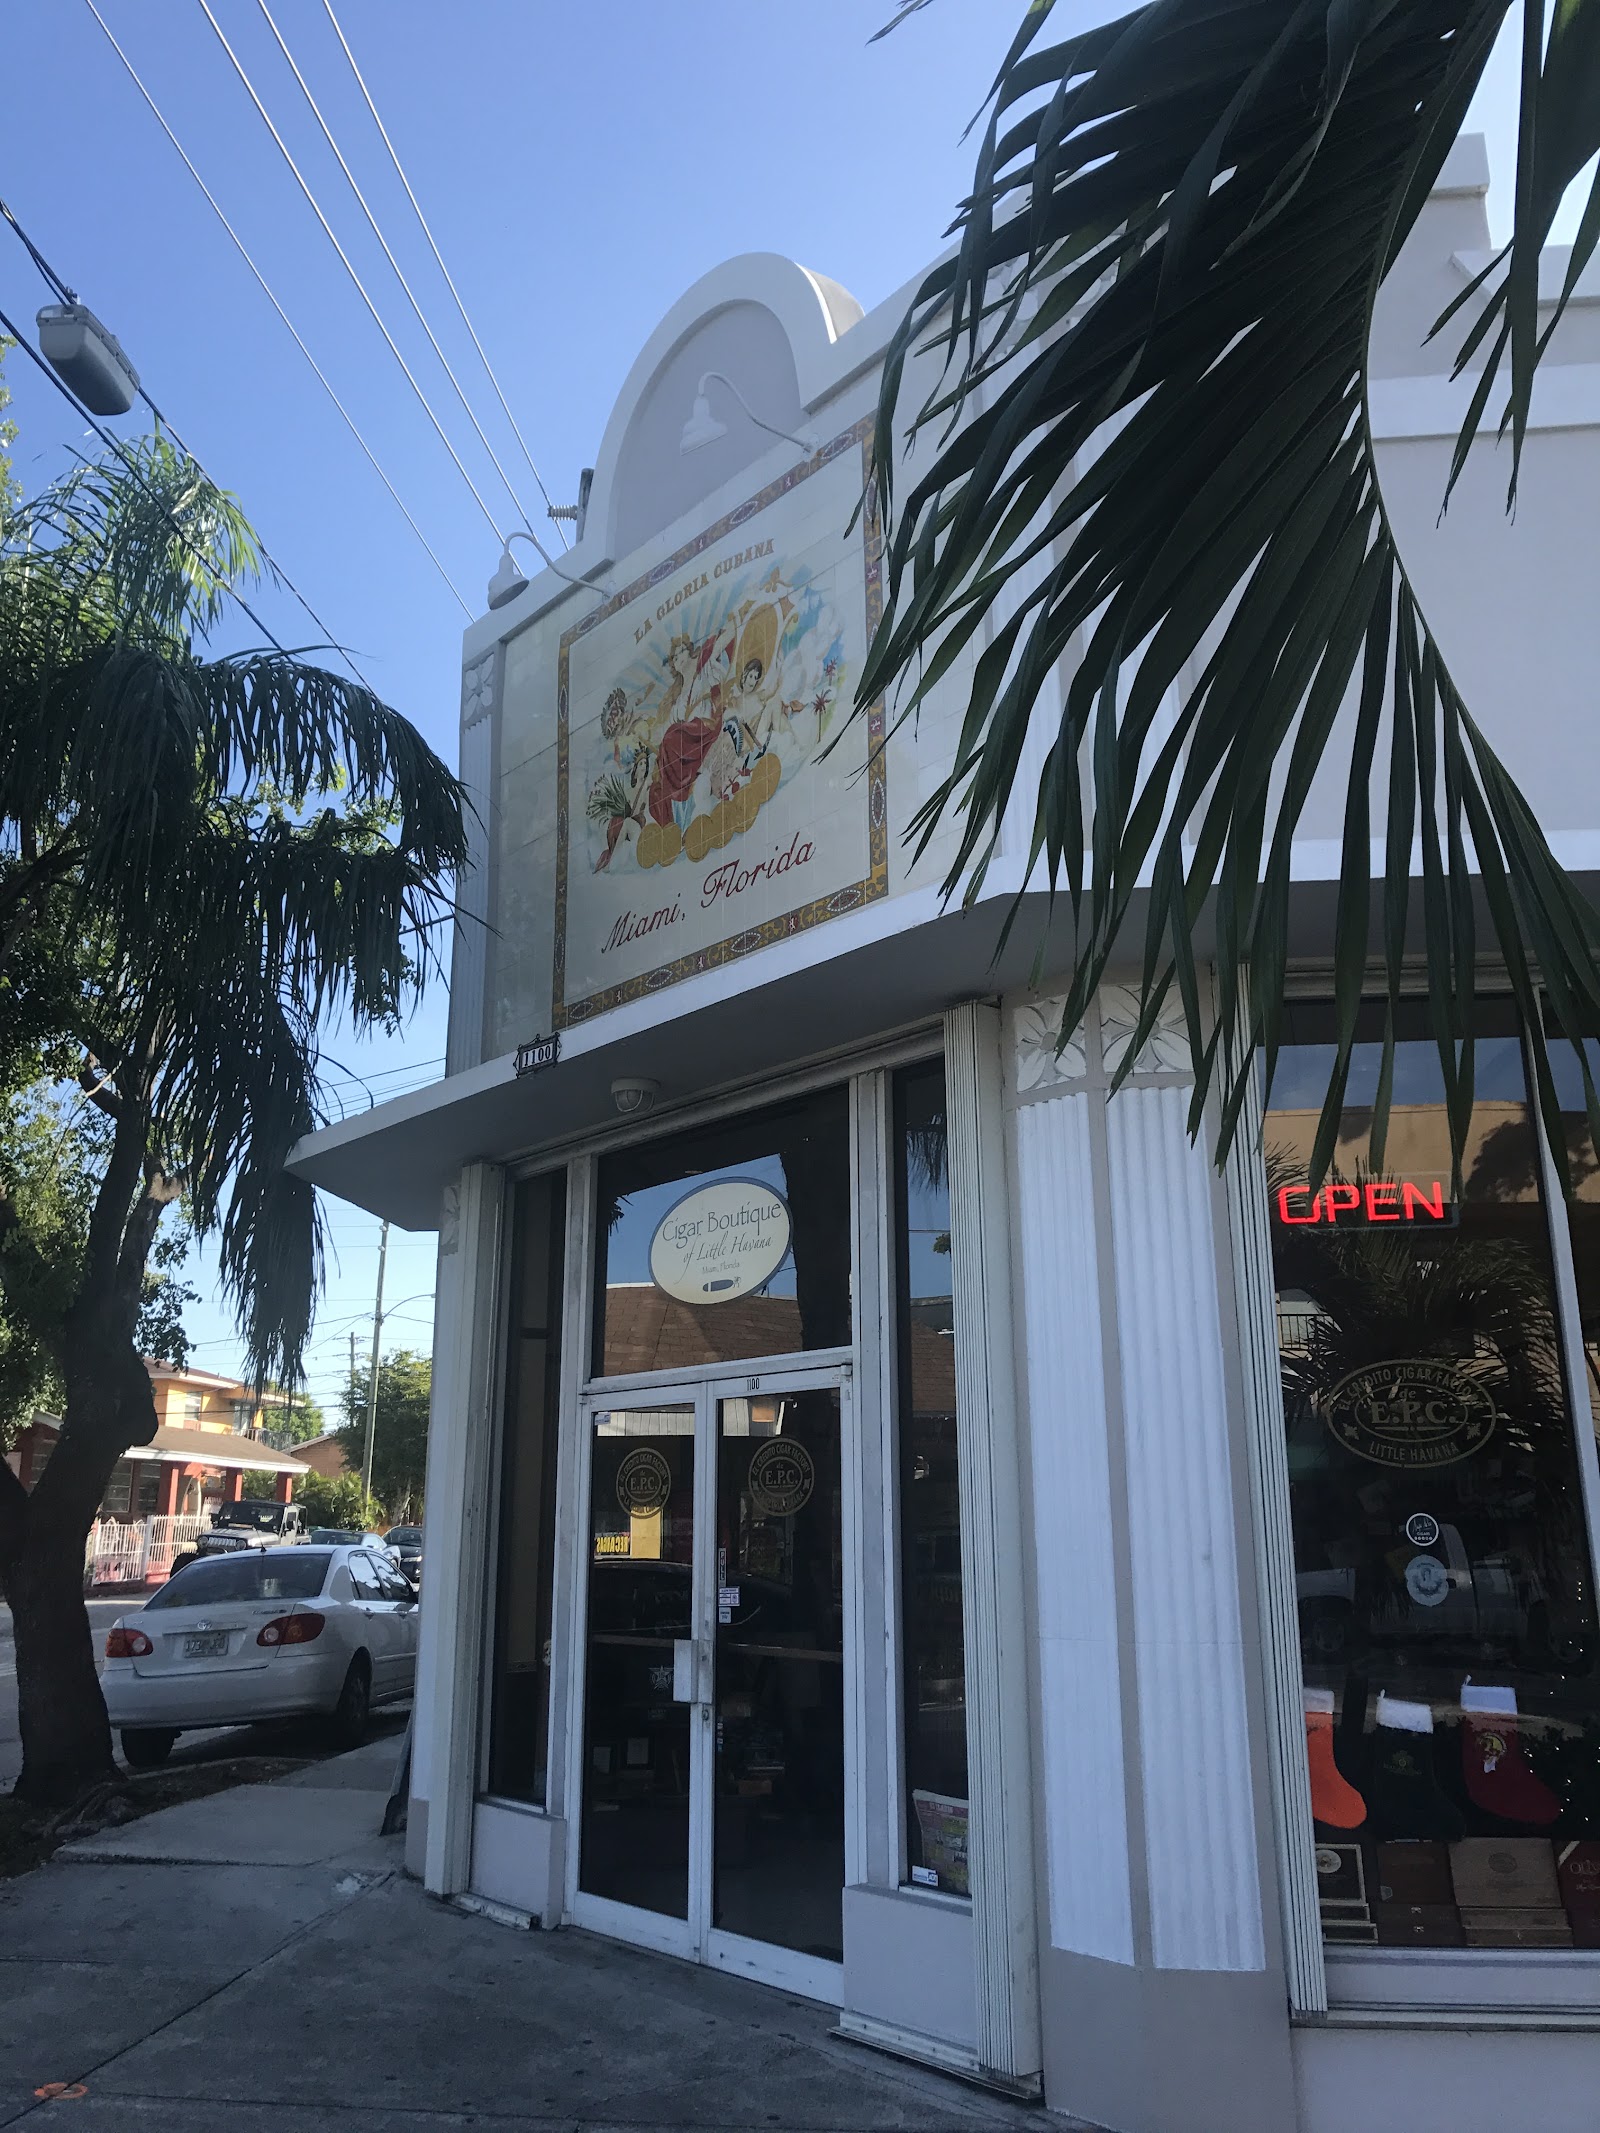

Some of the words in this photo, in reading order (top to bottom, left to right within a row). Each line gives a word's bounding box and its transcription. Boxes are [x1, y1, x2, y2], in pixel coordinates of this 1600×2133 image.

[633, 618, 652, 645] LA
[656, 571, 709, 620] GLORIA
[713, 538, 775, 579] CUBANA
[601, 892, 686, 954] Miami,
[700, 831, 817, 909] Florida
[524, 1045, 551, 1067] 1100
[1278, 1181, 1444, 1224] OPEN
[662, 1217, 703, 1249] Cigar
[707, 1201, 782, 1236] Boutique
[674, 1232, 702, 1285] of
[696, 1230, 729, 1261] Little
[731, 1231, 772, 1254] Havana
[747, 1378, 759, 1391] 1100
[1347, 1369, 1391, 1398] CREDITO
[1395, 1366, 1432, 1379] CIGAR
[1400, 1388, 1416, 1399] de
[1371, 1401, 1457, 1424] E.P.C.
[1369, 1441, 1405, 1461] LITTLE
[1410, 1442, 1459, 1461] HAVANA
[776, 1461, 784, 1469] de
[630, 1477, 657, 1490] E.P.C.
[765, 1470, 798, 1485] E.P.C.
